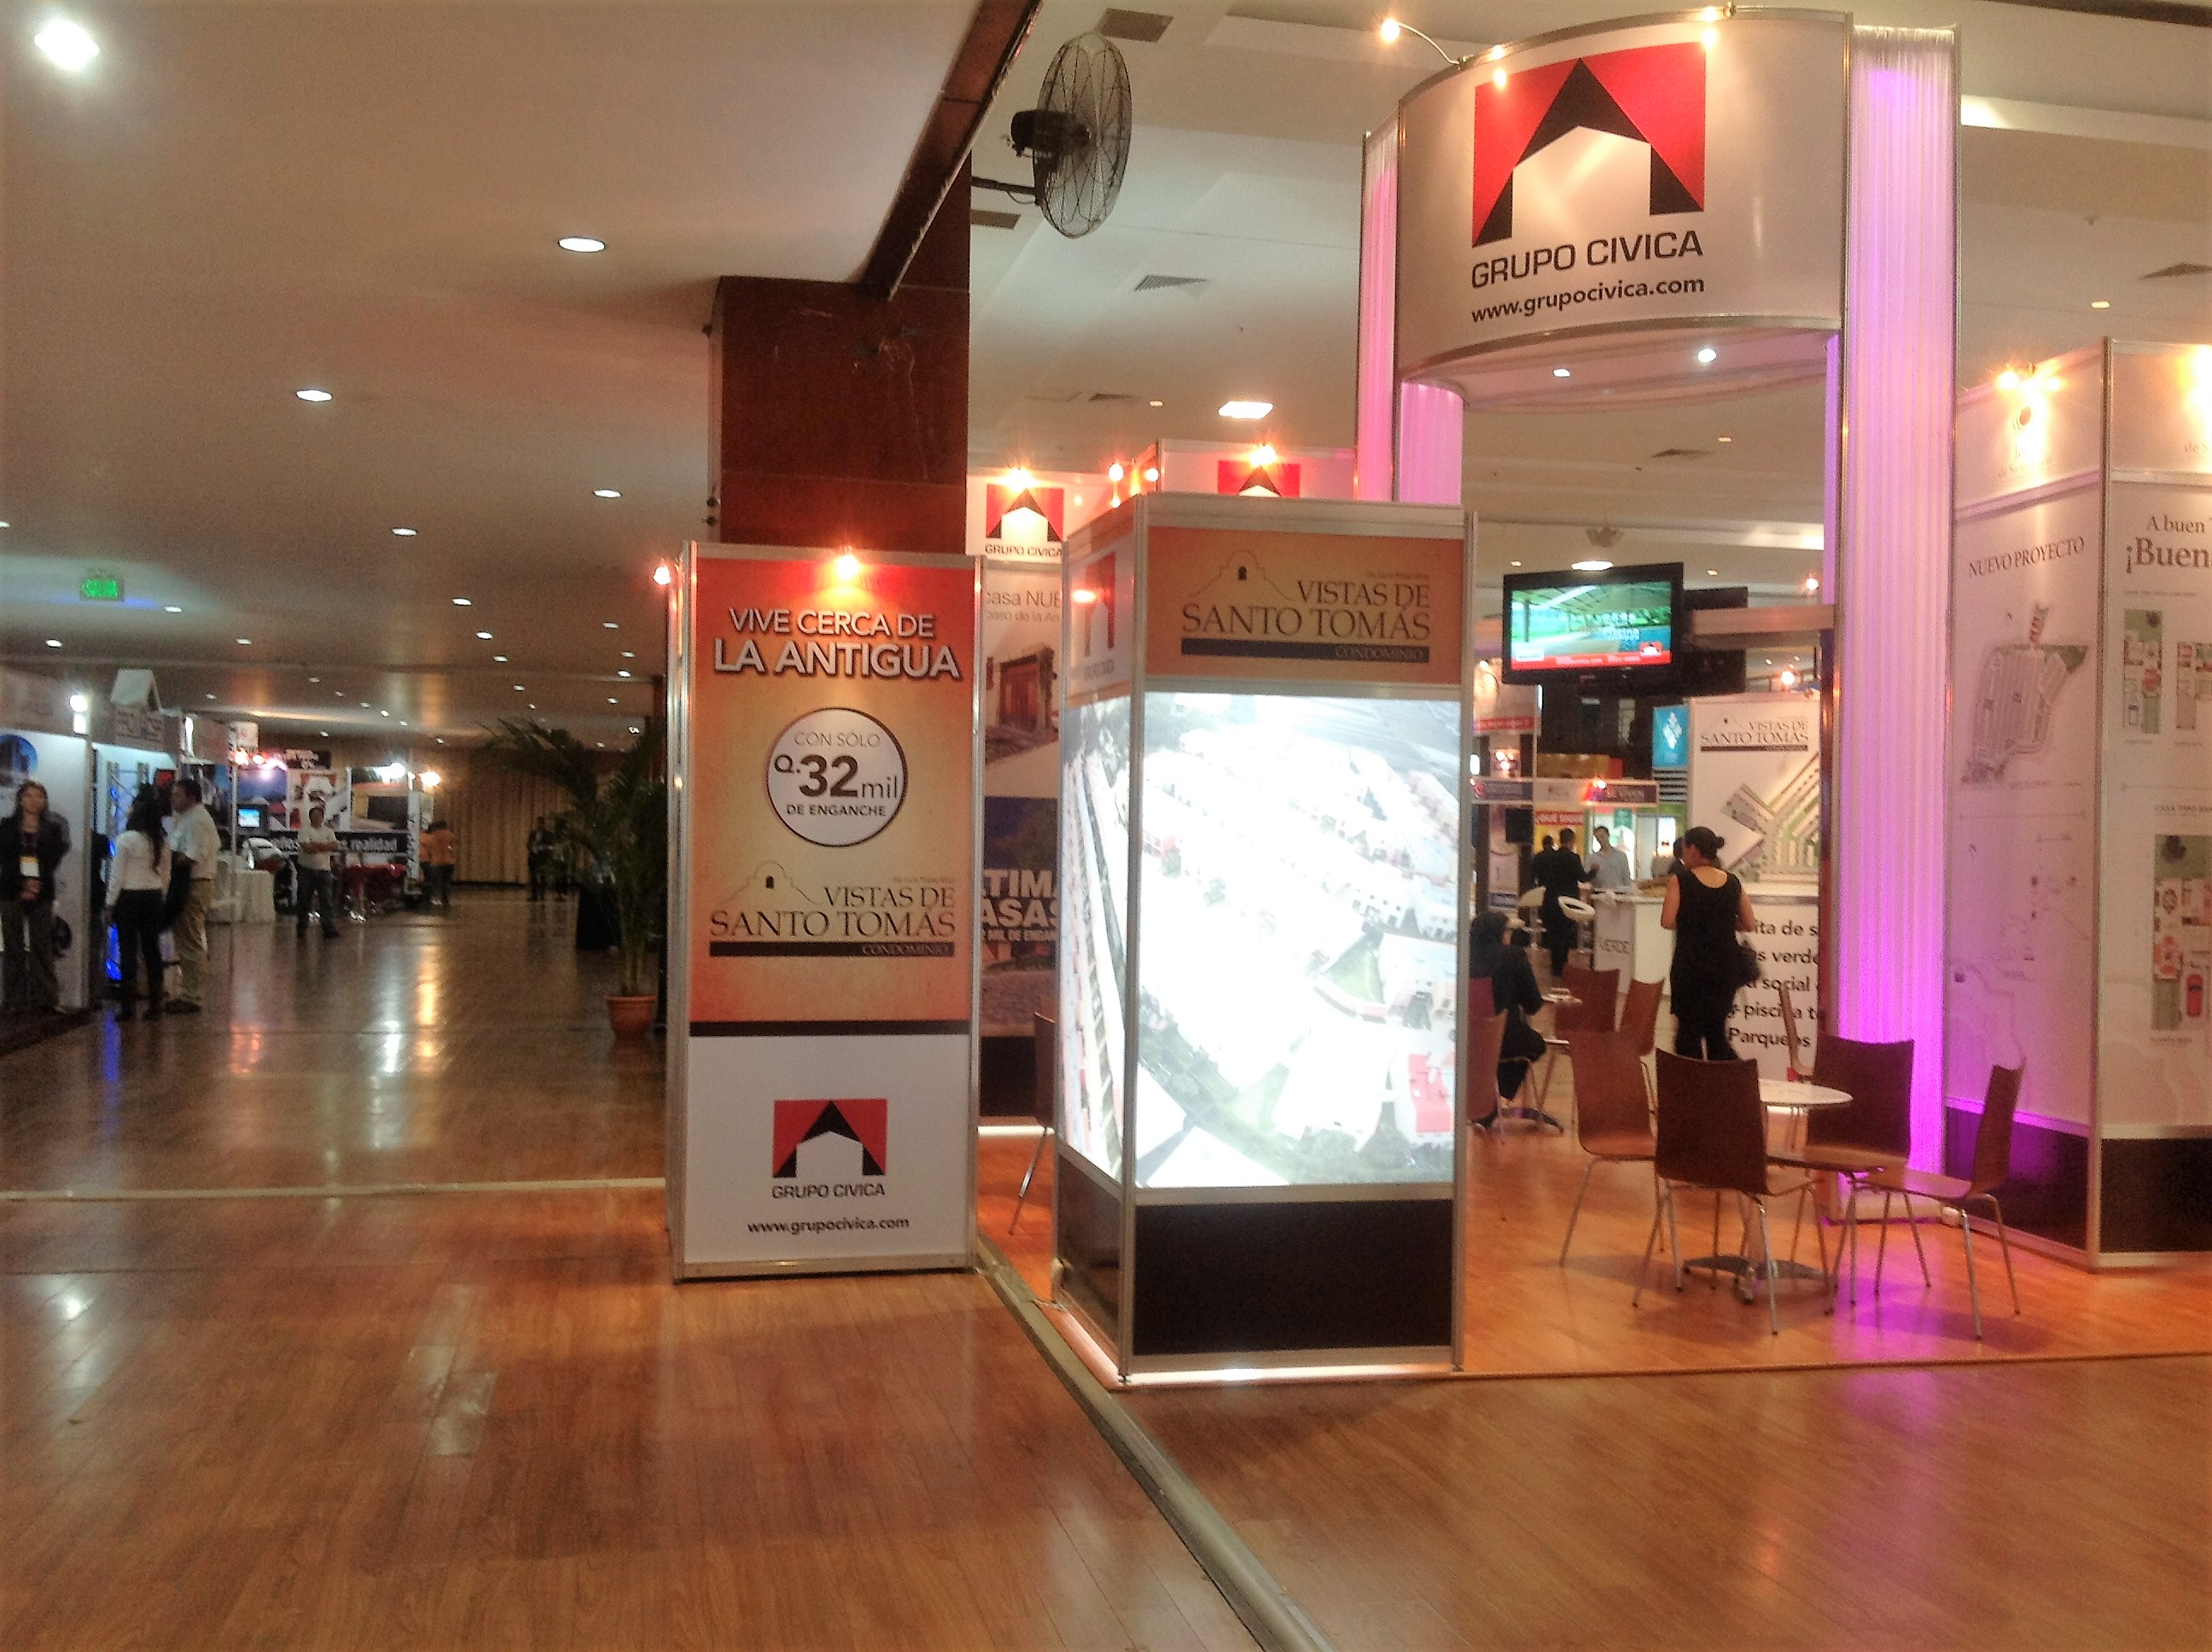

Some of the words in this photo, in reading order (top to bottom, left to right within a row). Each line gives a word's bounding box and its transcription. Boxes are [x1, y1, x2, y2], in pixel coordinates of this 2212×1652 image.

[1471, 244, 1575, 288] GRUPO
[1586, 230, 1703, 266] CIVICA
[1471, 278, 1705, 323] www.grupocivica.com
[2148, 515, 2158, 532] A
[2163, 515, 2206, 533] buen
[985, 544, 1025, 556] GRUPO
[1027, 546, 1062, 557] CIVICA
[1968, 554, 2012, 578] NUEVO
[2014, 535, 2085, 567] PROYECTO
[2126, 537, 2212, 574] ¡Buen
[1297, 579, 1388, 608] VISTAS
[1394, 583, 1430, 609] DE
[729, 607, 791, 634] VIVE
[796, 609, 891, 638] CERCA
[897, 614, 934, 639] DE
[1182, 603, 1303, 637] SANTO
[713, 637, 766, 674] LA
[774, 640, 962, 680] ANTIGUA
[1749, 720, 1790, 731] VISTAS
[794, 731, 833, 747] CON
[836, 730, 881, 747] SÓLO
[1700, 731, 1751, 744] SANTO
[786, 805, 805, 817] DE
[809, 804, 887, 817] ENGANCHE
[983, 867, 1058, 899] TIM
[823, 885, 914, 908] VISTAS
[919, 886, 956, 909] DE
[709, 910, 830, 938] SANTO
[1781, 919, 1804, 936] de
[1744, 1001, 1802, 1021] piscia
[1728, 1027, 1812, 1049] Parques
[771, 1184, 830, 1200] GRUPO
[833, 1182, 886, 1198] CIVICA
[746, 1216, 911, 1236] www.grupocivica.com
